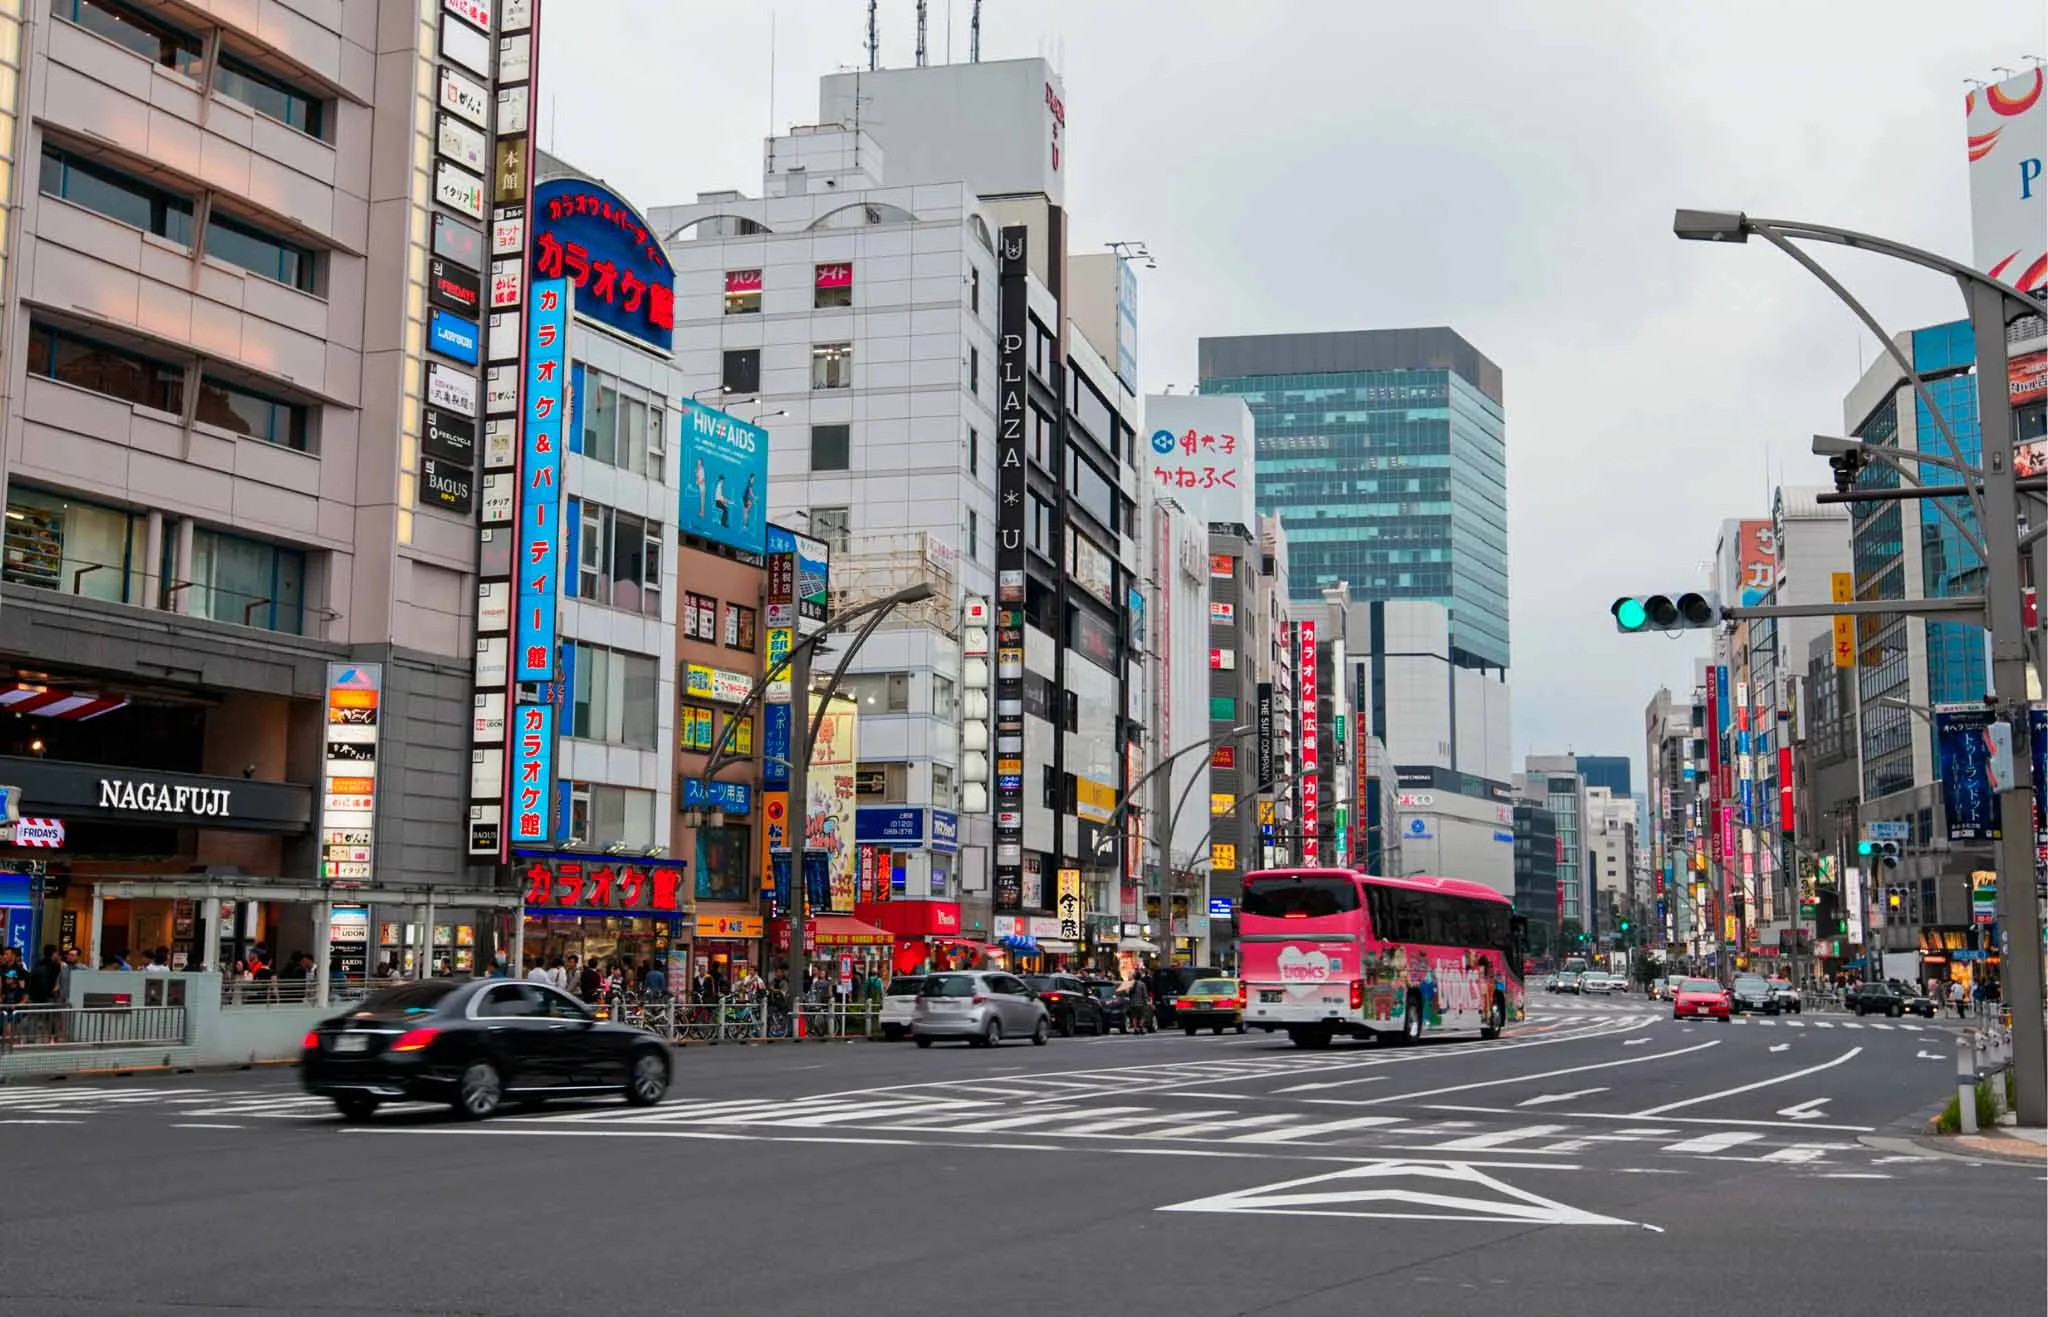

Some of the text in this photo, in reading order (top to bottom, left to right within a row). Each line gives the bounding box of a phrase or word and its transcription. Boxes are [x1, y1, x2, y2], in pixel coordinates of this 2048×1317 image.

[503, 151, 520, 191] 本館
[537, 231, 674, 331] カラオケ館
[1003, 335, 1022, 467] PLAZA
[429, 474, 468, 498] BAGUS
[527, 289, 558, 669] カラオケ&パーティー館
[1154, 466, 1237, 489] かねふく
[1261, 716, 1269, 734] SUIT
[520, 708, 543, 836] カラオケ館
[1261, 736, 1269, 782] COMPANY
[99, 779, 231, 816] NAGAFUJI
[1398, 793, 1433, 806] PARCO
[23, 827, 58, 839] FRIDAYS
[526, 862, 683, 911] カラオケ館
